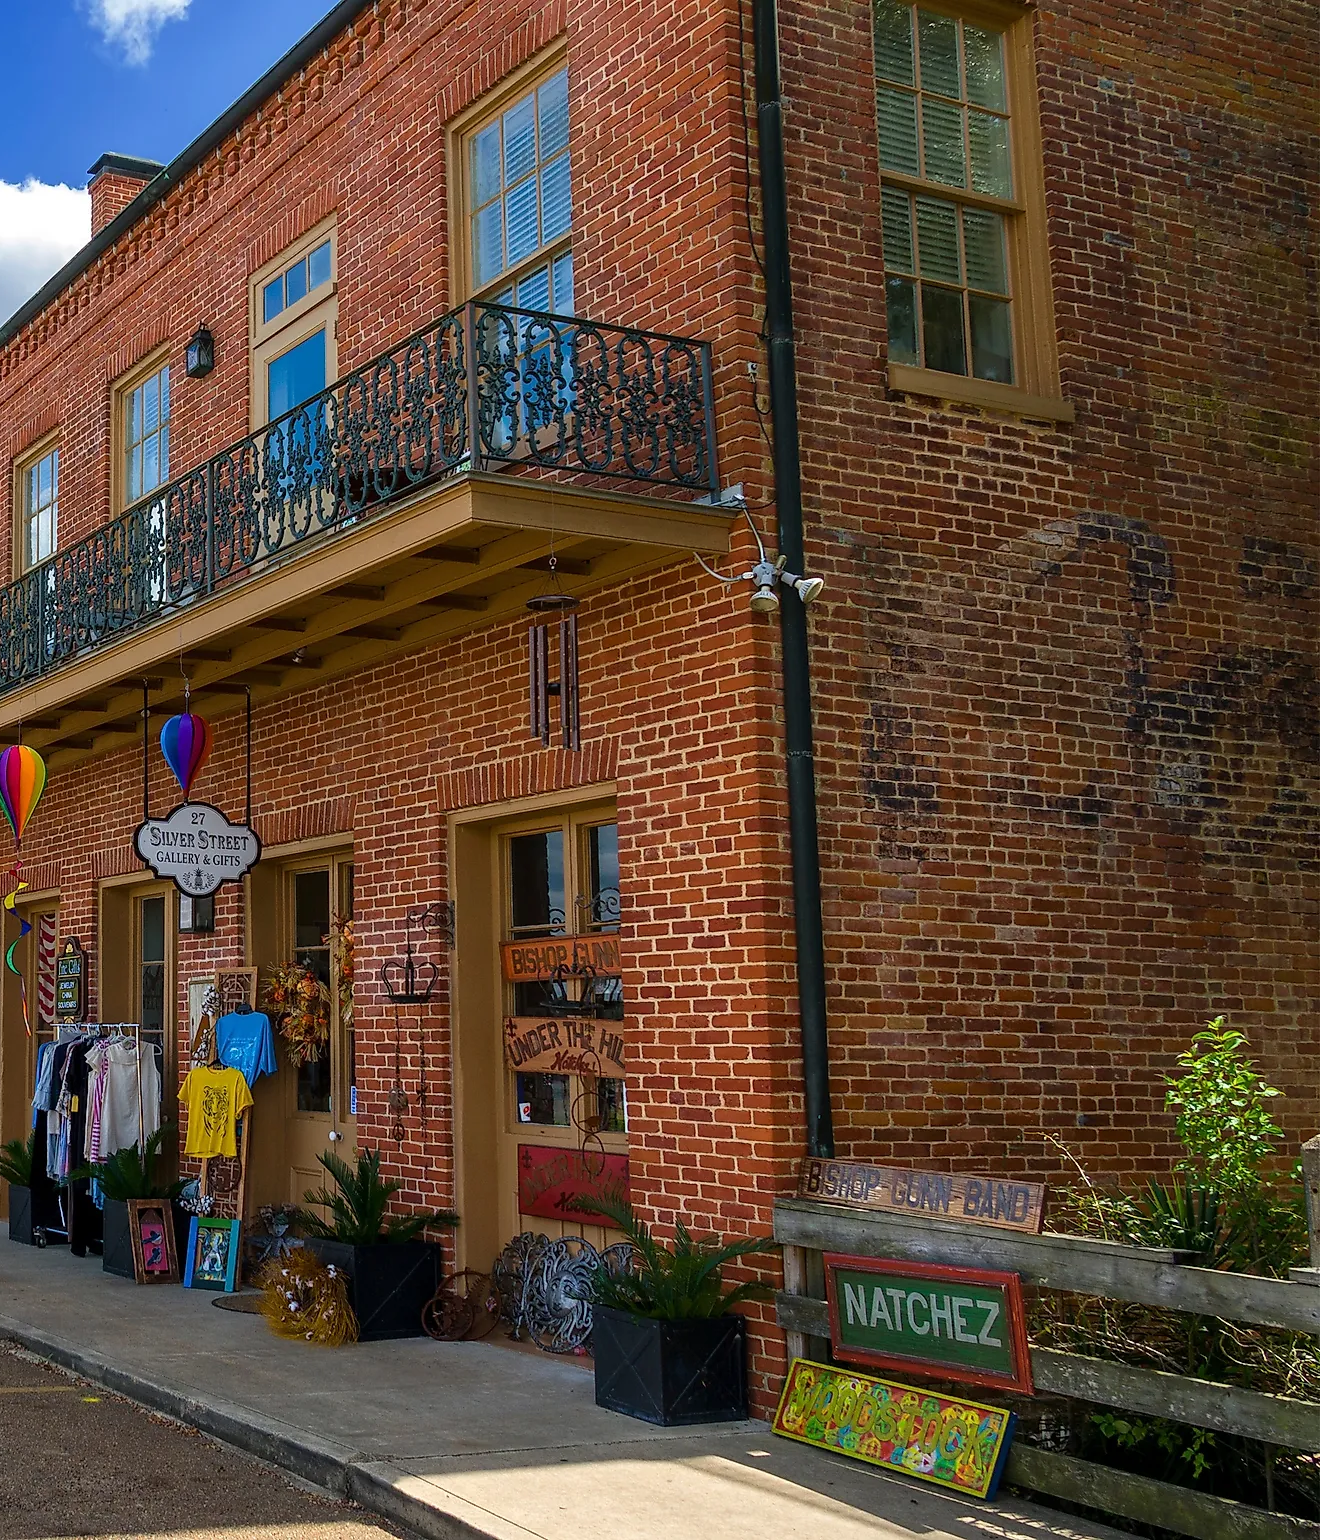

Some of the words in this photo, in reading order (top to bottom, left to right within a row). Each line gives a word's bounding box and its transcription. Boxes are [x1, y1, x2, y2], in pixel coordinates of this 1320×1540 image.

[150, 826, 195, 848] SILVER
[197, 829, 249, 851] STREET
[191, 812, 206, 825] 27
[156, 850, 201, 865] GALLERY
[202, 854, 211, 865] &
[212, 854, 241, 867] GIFTS
[511, 945, 568, 974] BISHOP
[575, 940, 621, 969] GUNN
[508, 1021, 562, 1067] UNDER
[807, 1161, 881, 1201] BISHOP
[891, 1170, 952, 1213] GUNN
[964, 1180, 1029, 1222] BAND
[843, 1282, 1002, 1348] NATCHEZ
[792, 1382, 993, 1471] WOODSTOCK
